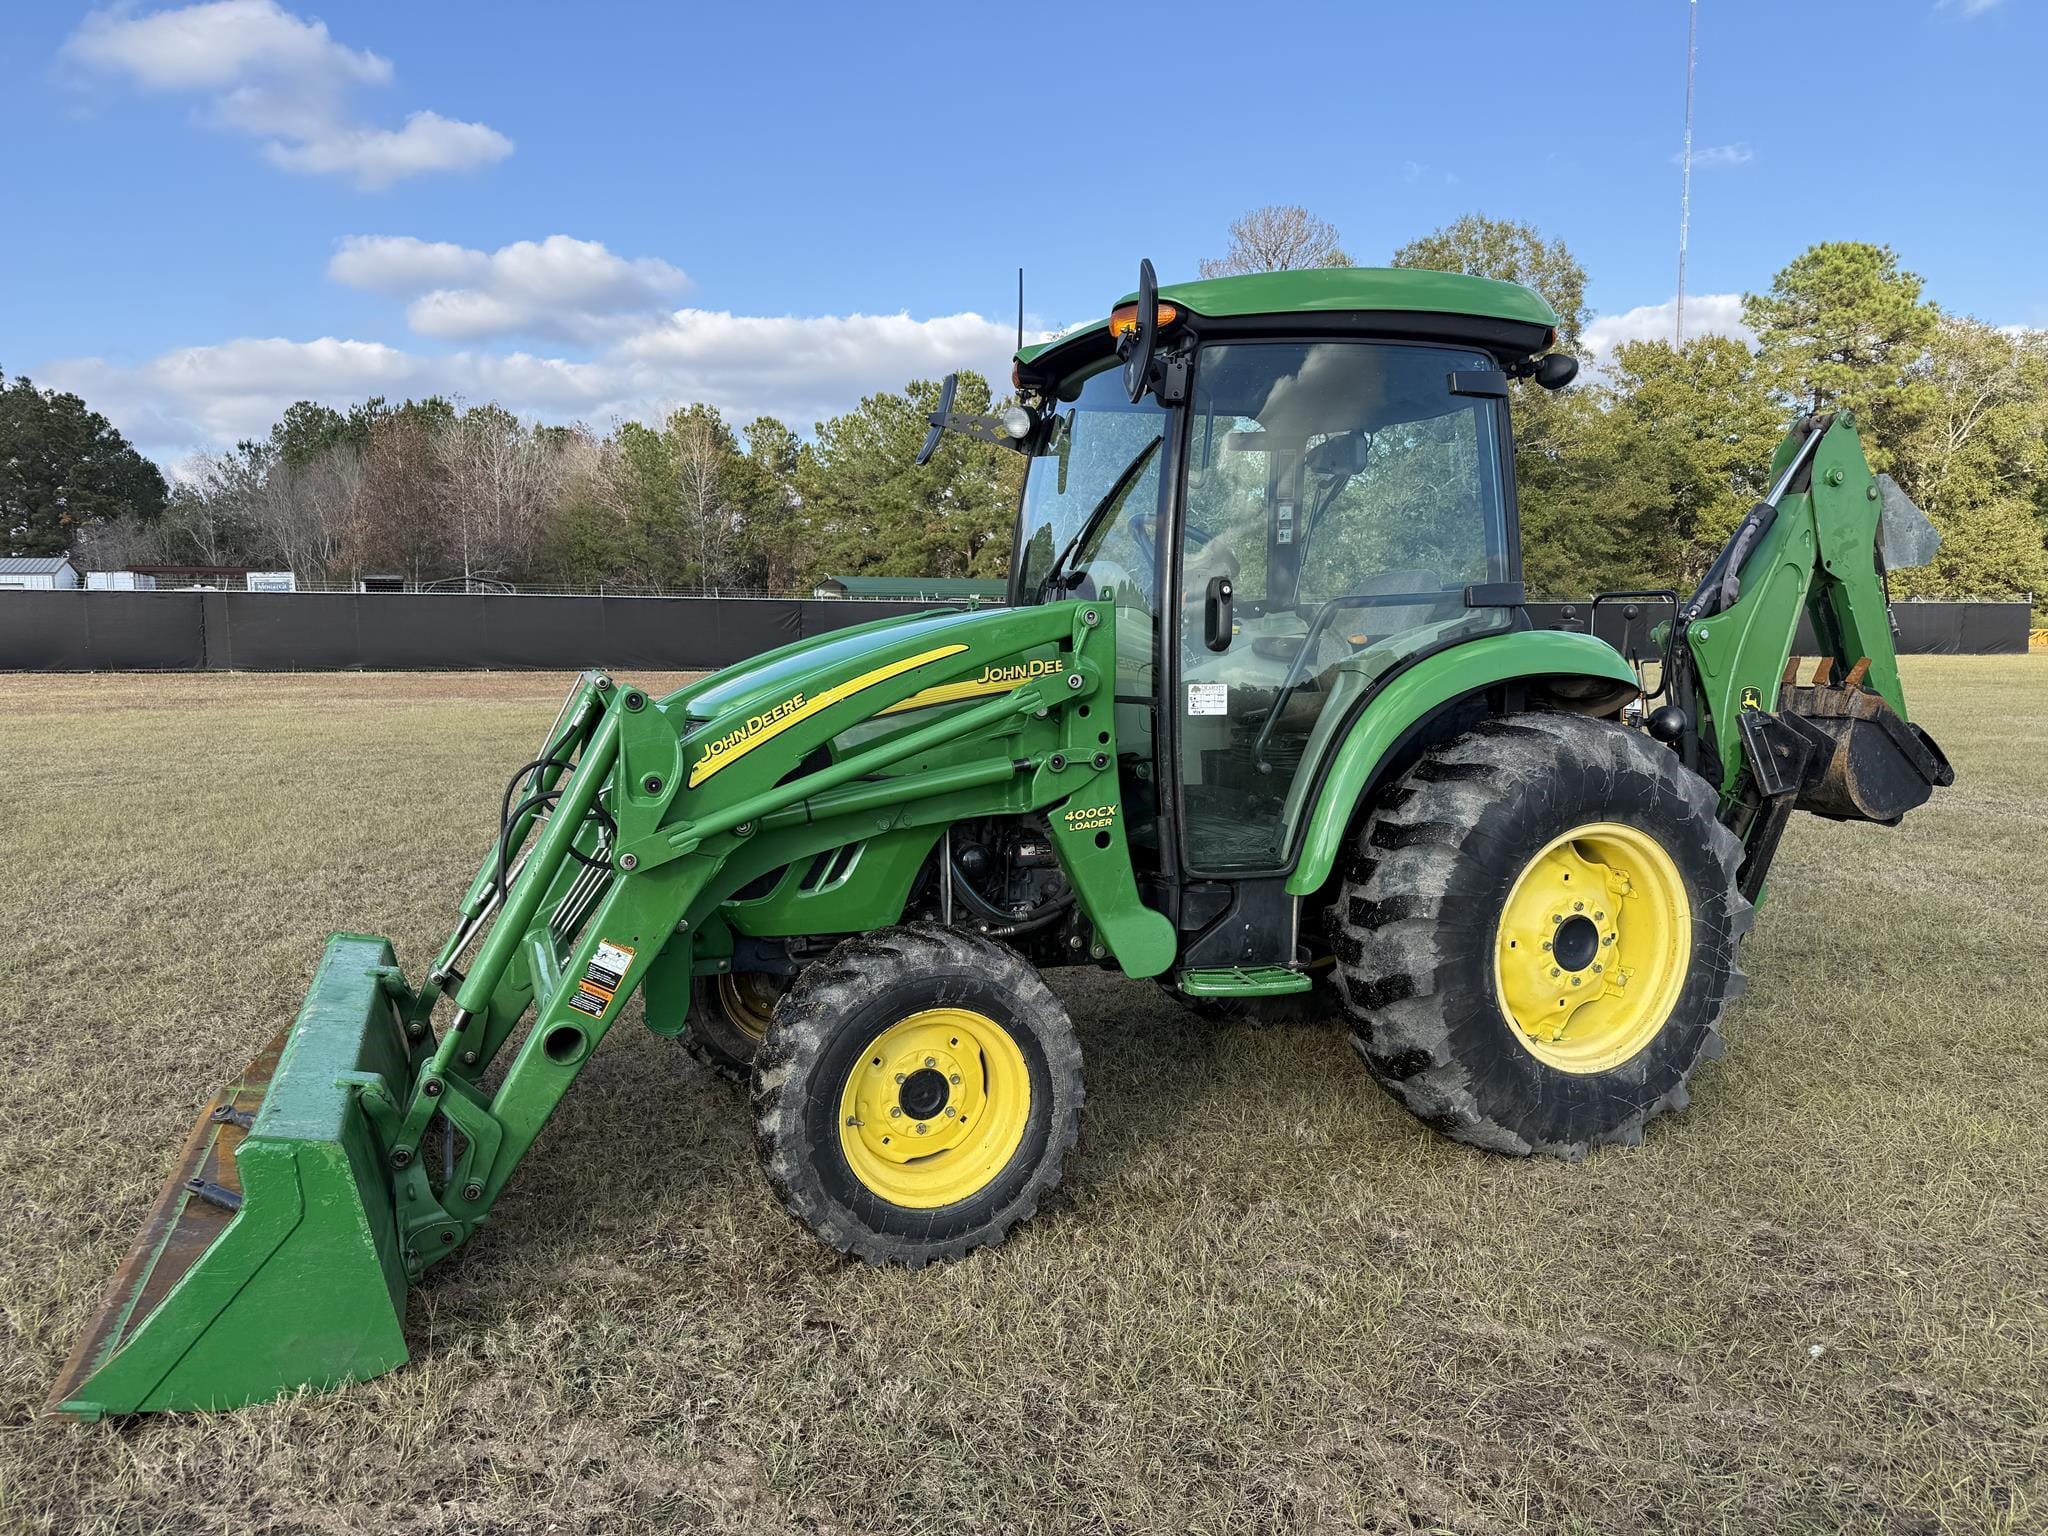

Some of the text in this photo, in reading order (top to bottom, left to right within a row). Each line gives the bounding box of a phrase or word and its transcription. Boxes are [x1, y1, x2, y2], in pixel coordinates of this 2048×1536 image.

[978, 659, 1064, 684] JOHN DEE
[701, 692, 807, 762] JOHN DEERE
[1064, 804, 1118, 821] 400CX
[1069, 818, 1113, 832] LOADER
